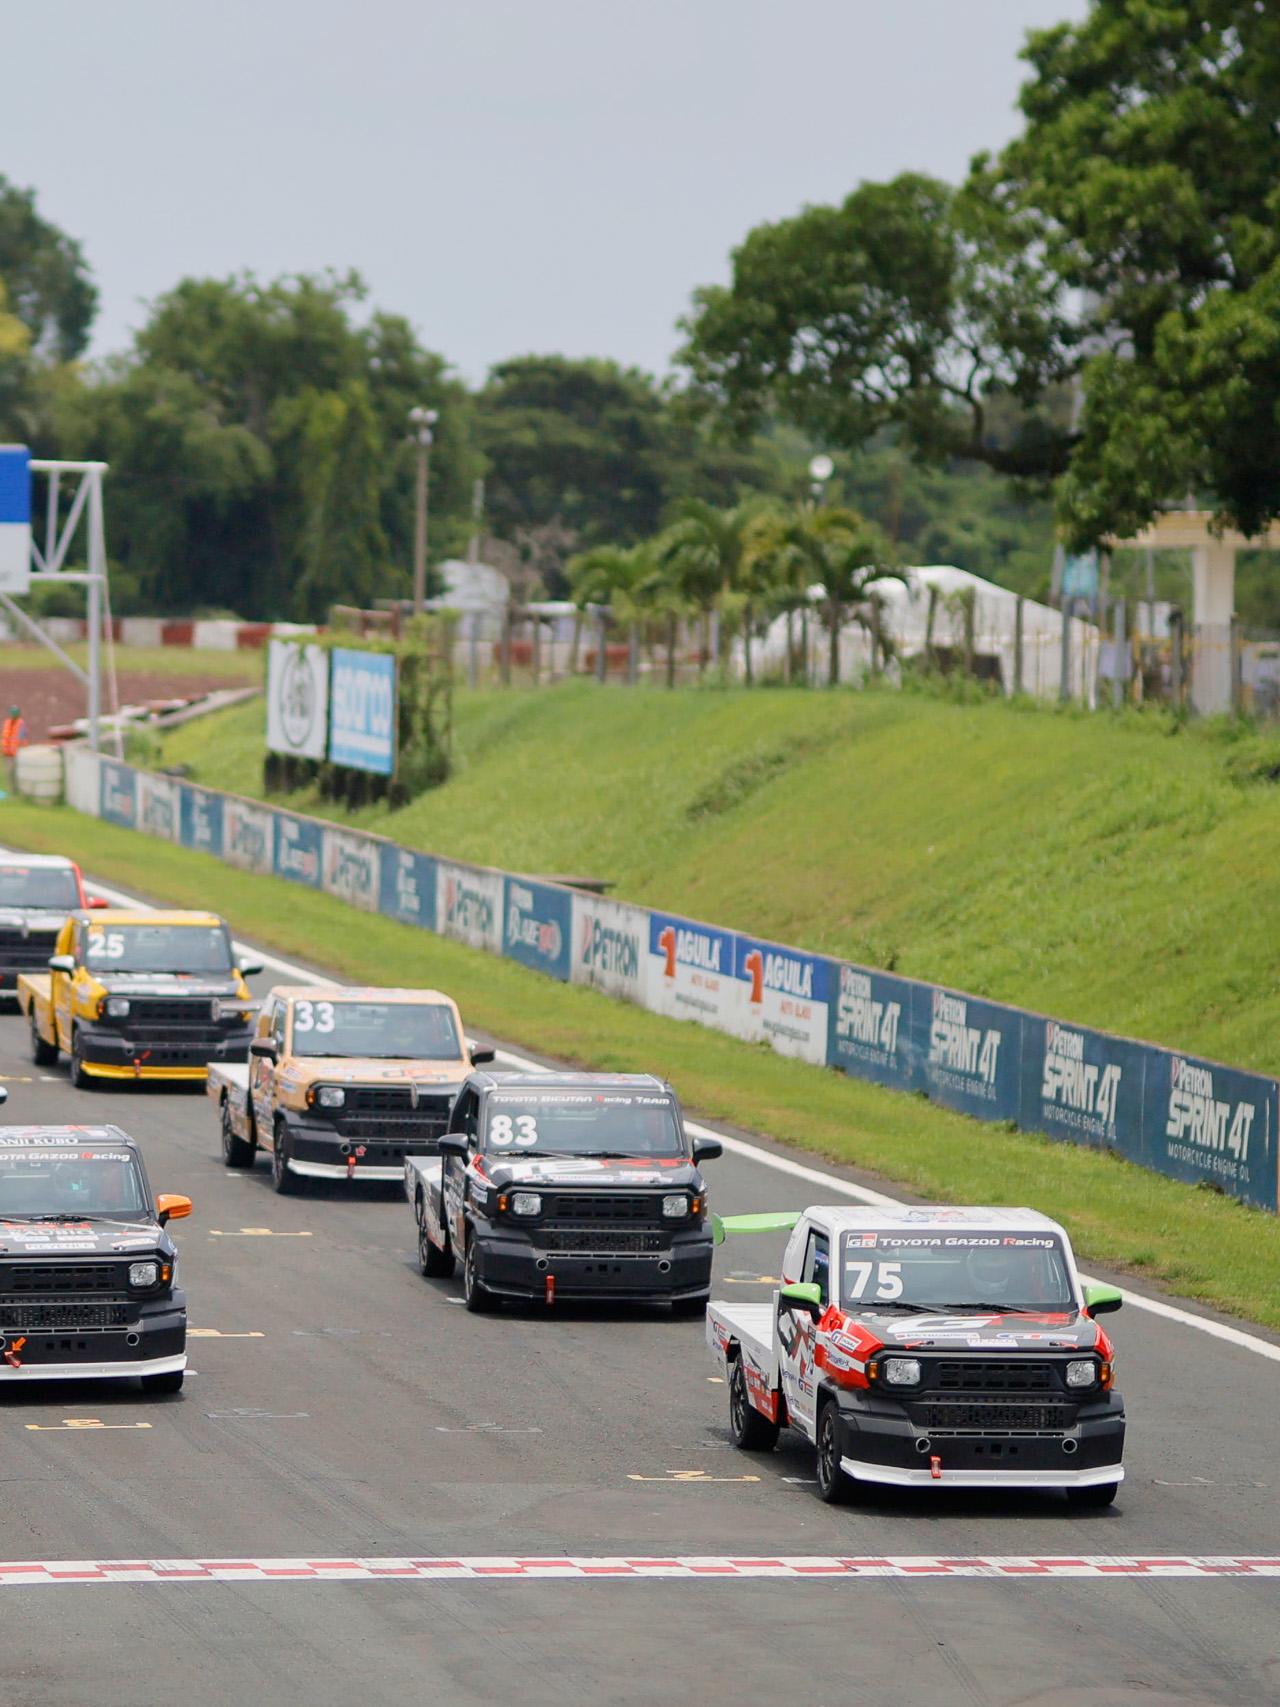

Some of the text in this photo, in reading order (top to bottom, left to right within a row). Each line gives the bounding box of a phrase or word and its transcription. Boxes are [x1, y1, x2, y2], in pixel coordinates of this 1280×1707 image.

[87, 933, 125, 958] 25
[592, 918, 639, 980] PETRON
[676, 929, 721, 973] AGUILA
[764, 953, 812, 998] AGUILA
[294, 1000, 335, 1033] 33
[837, 992, 883, 1045] SPRINT
[881, 1001, 902, 1053] 4T
[939, 992, 967, 1026] PETRON
[929, 1018, 1001, 1083] SPRINT 4T
[1052, 1023, 1084, 1060] PETRON
[1042, 1052, 1122, 1123] SPRINT 4T
[1178, 1059, 1213, 1098] PETRON
[32, 1138, 79, 1146] KUBO
[490, 1114, 538, 1146] 83
[1166, 1088, 1255, 1161] SPRINT 4T
[28, 1152, 79, 1161] GAZOO
[81, 1152, 131, 1162] Racing
[1167, 1141, 1251, 1182] MOTORCYCLE ENGINE OIL
[848, 1235, 1054, 1248] GR TOYOTA GAZOO Racing
[846, 1261, 904, 1300] 75
